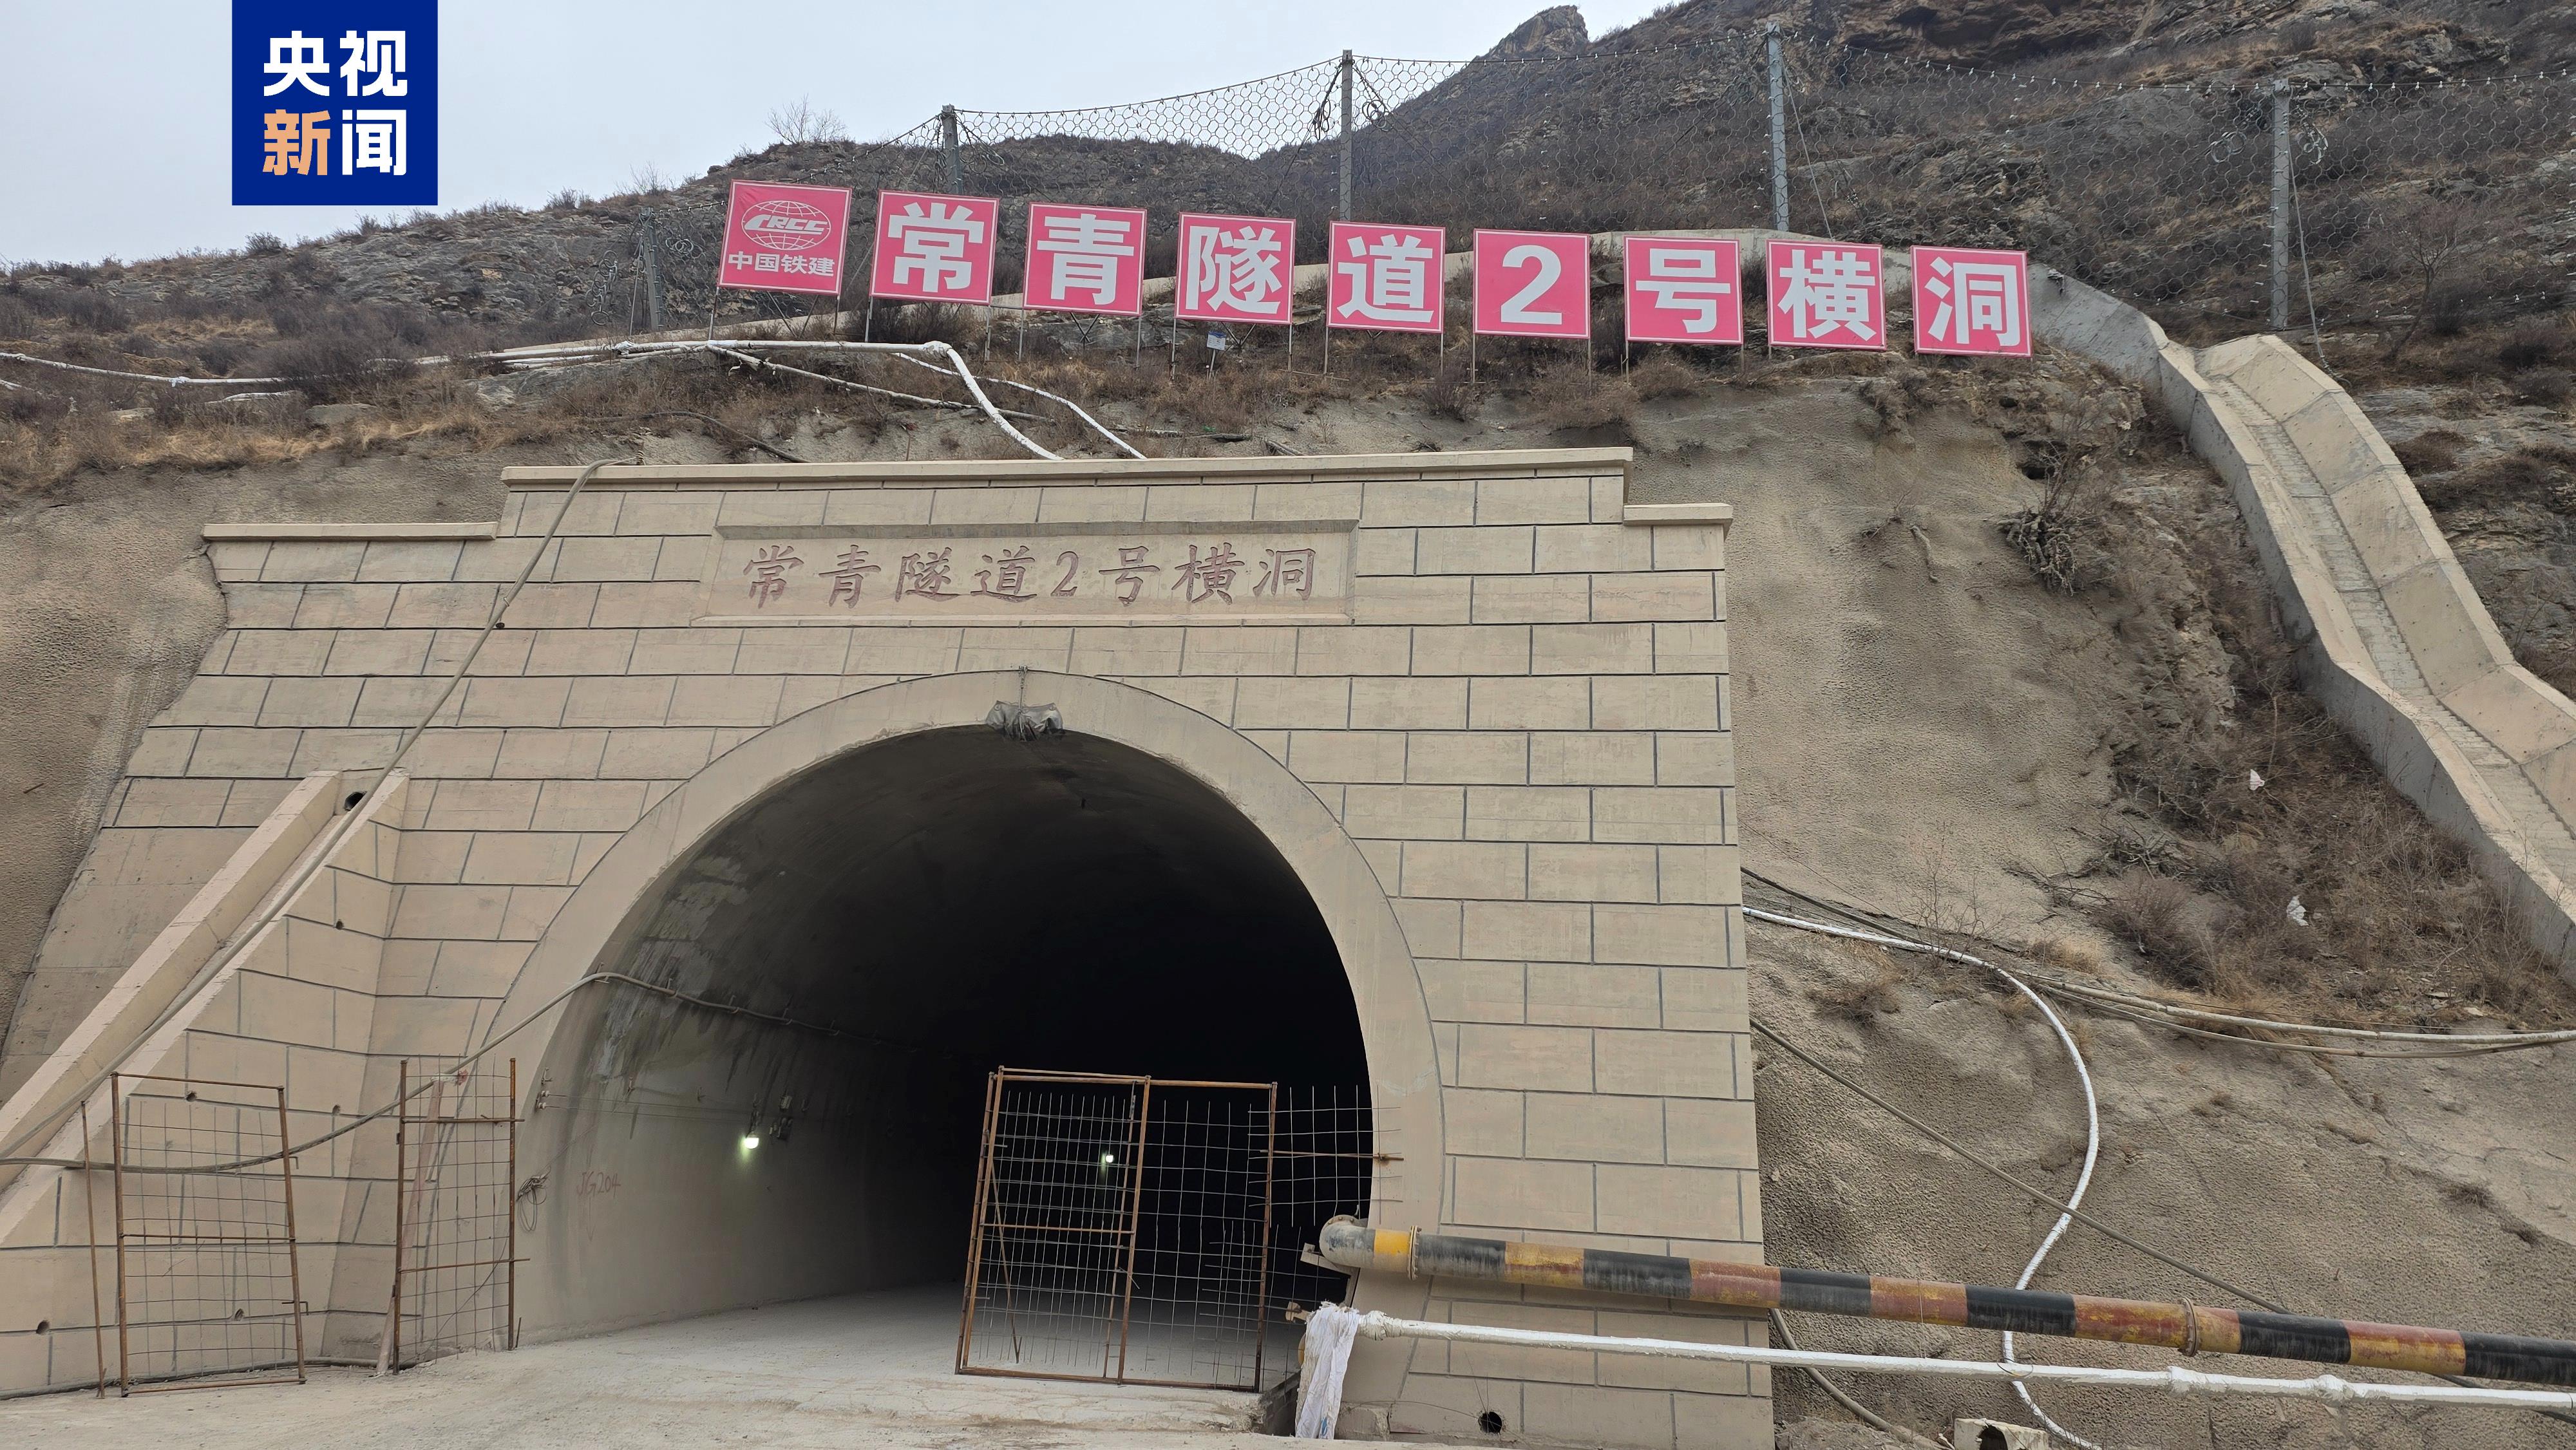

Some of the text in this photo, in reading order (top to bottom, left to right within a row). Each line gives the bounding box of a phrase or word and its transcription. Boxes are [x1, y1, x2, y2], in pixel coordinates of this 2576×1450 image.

[744, 214, 828, 235] CRCC
[728, 250, 835, 277] 中国铁建
[887, 202, 2020, 346] 常青隧道2号横洞
[743, 543, 1316, 607] 常青隧道2号横洞
